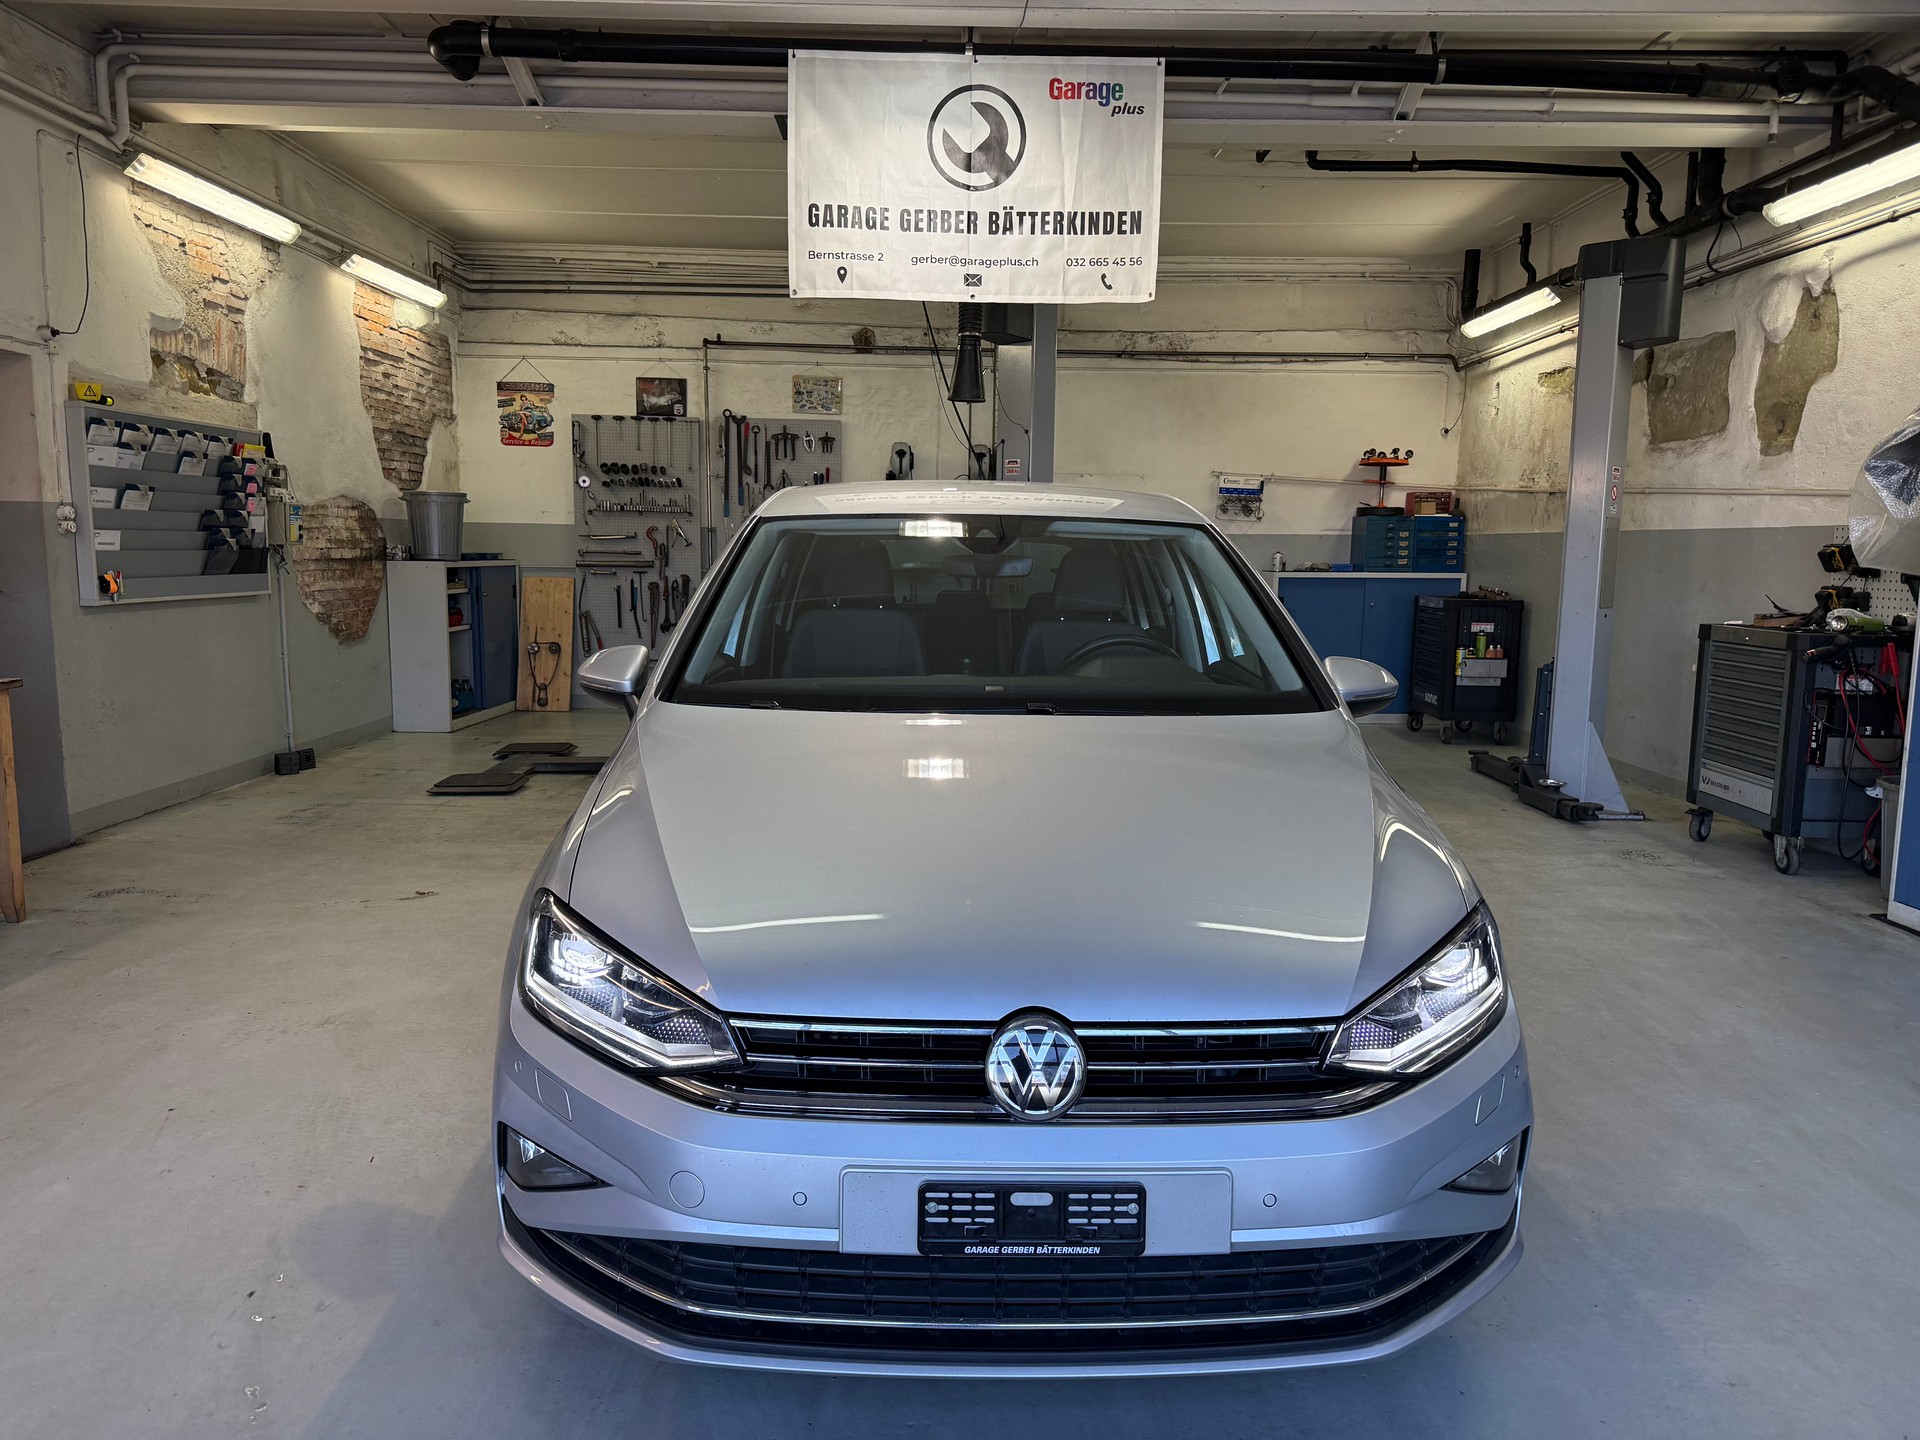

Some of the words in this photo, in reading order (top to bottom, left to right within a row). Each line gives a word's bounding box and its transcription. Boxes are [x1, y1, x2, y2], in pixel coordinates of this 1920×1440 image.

[1048, 77, 1124, 107] Garage
[1110, 102, 1145, 117] plus
[808, 203, 890, 231] GARAGE
[899, 208, 979, 235] GERBER
[988, 205, 1142, 236] BÄTTERKINDEN
[808, 250, 875, 261] Bernstrasse
[877, 252, 885, 262] 2
[910, 254, 1039, 268] gerber@garageplus.ch
[1065, 257, 1086, 267] 032
[1089, 257, 1109, 267] 665
[1112, 257, 1126, 266] 45
[1129, 256, 1143, 266] 56
[502, 438, 524, 446] Service
[964, 1245, 1000, 1254] GARAGE
[1001, 1245, 1035, 1254] GERBER
[1036, 1244, 1101, 1254] BÄTTERKINDEN
